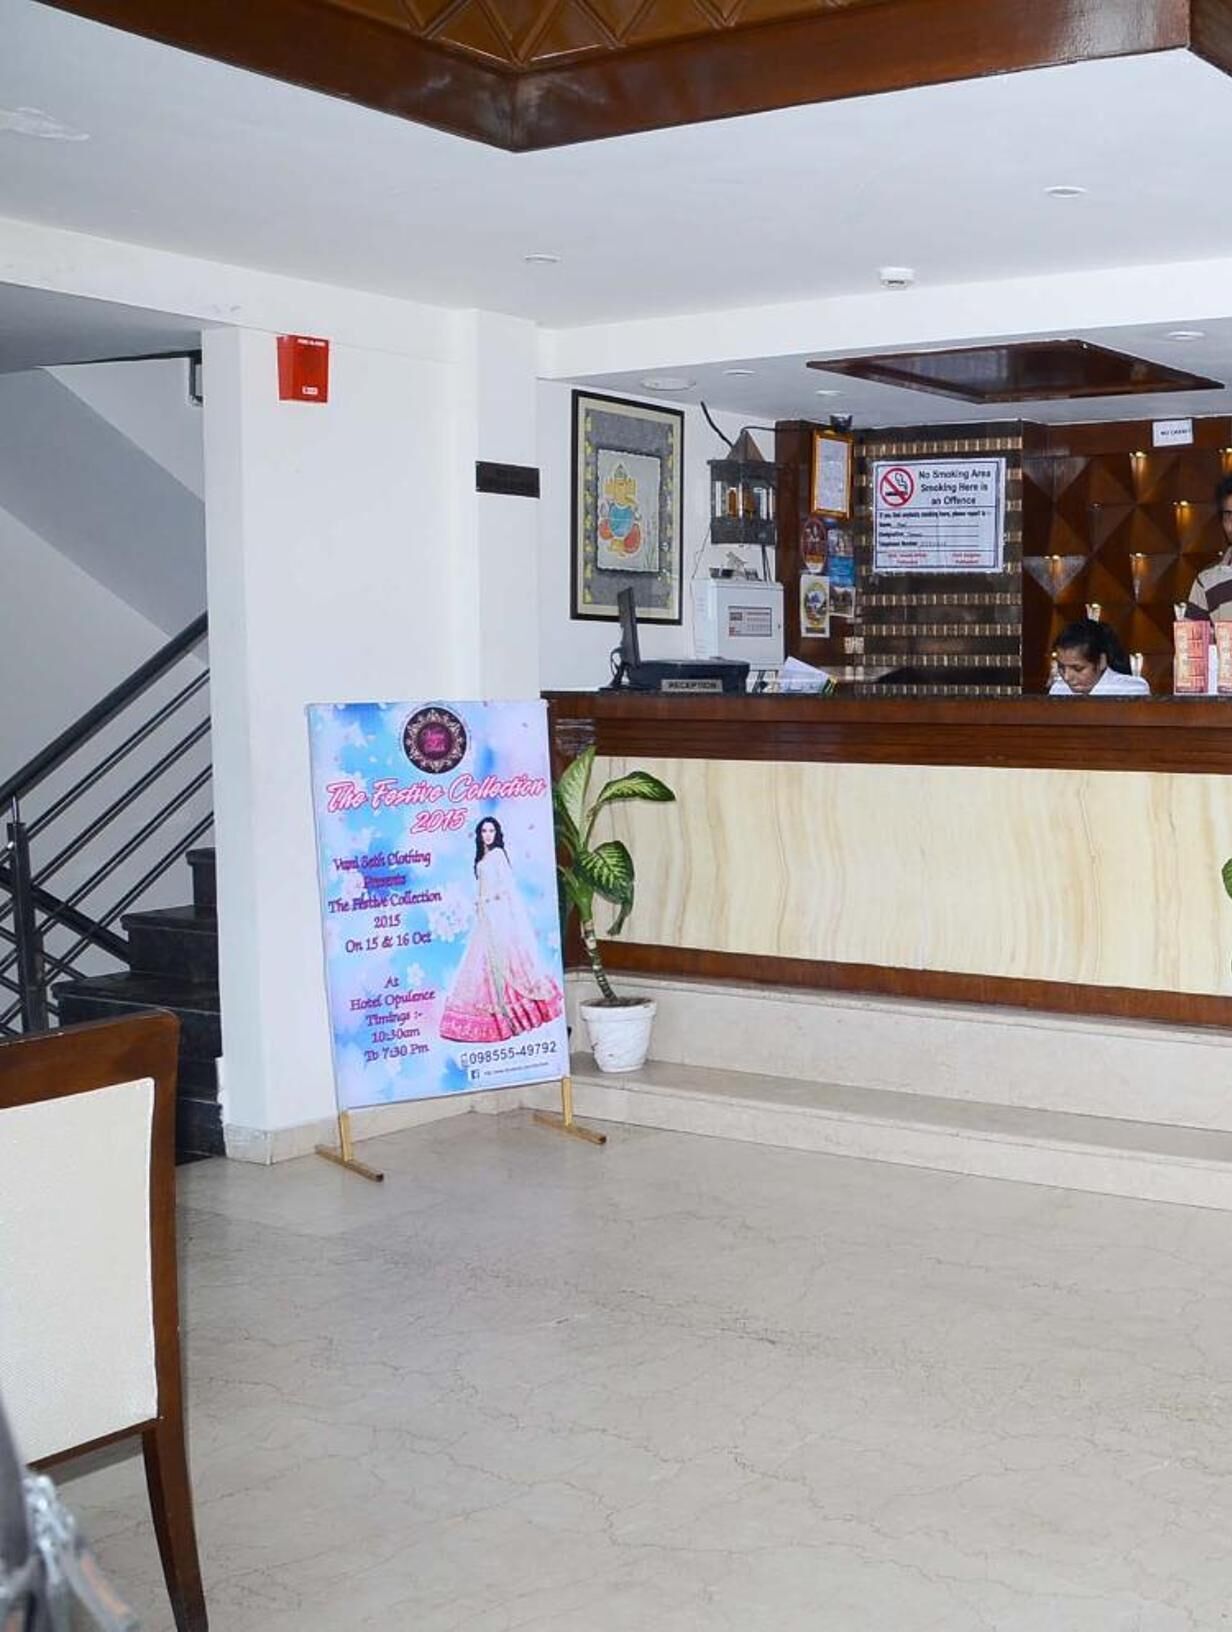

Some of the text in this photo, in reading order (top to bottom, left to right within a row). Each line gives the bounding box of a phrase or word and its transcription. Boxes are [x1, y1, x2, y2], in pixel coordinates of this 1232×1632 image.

[932, 470, 970, 480] Smoking
[972, 469, 991, 478] Area
[921, 482, 988, 493] Smoking Here is
[944, 496, 976, 505] Offence
[327, 774, 546, 812] The Festive Collection
[411, 808, 467, 834] 2015
[387, 849, 431, 868] Clothing
[328, 898, 349, 914] The
[390, 890, 442, 906] Collection
[374, 914, 401, 928] 2015
[346, 932, 432, 953] On 15 & 16 Oct
[384, 976, 400, 988] At
[350, 989, 436, 1011] Hotel Opulence
[366, 1011, 410, 1026] Timings
[364, 1044, 430, 1062] To 7:30 Pm
[469, 1040, 557, 1064] 098555-49792
